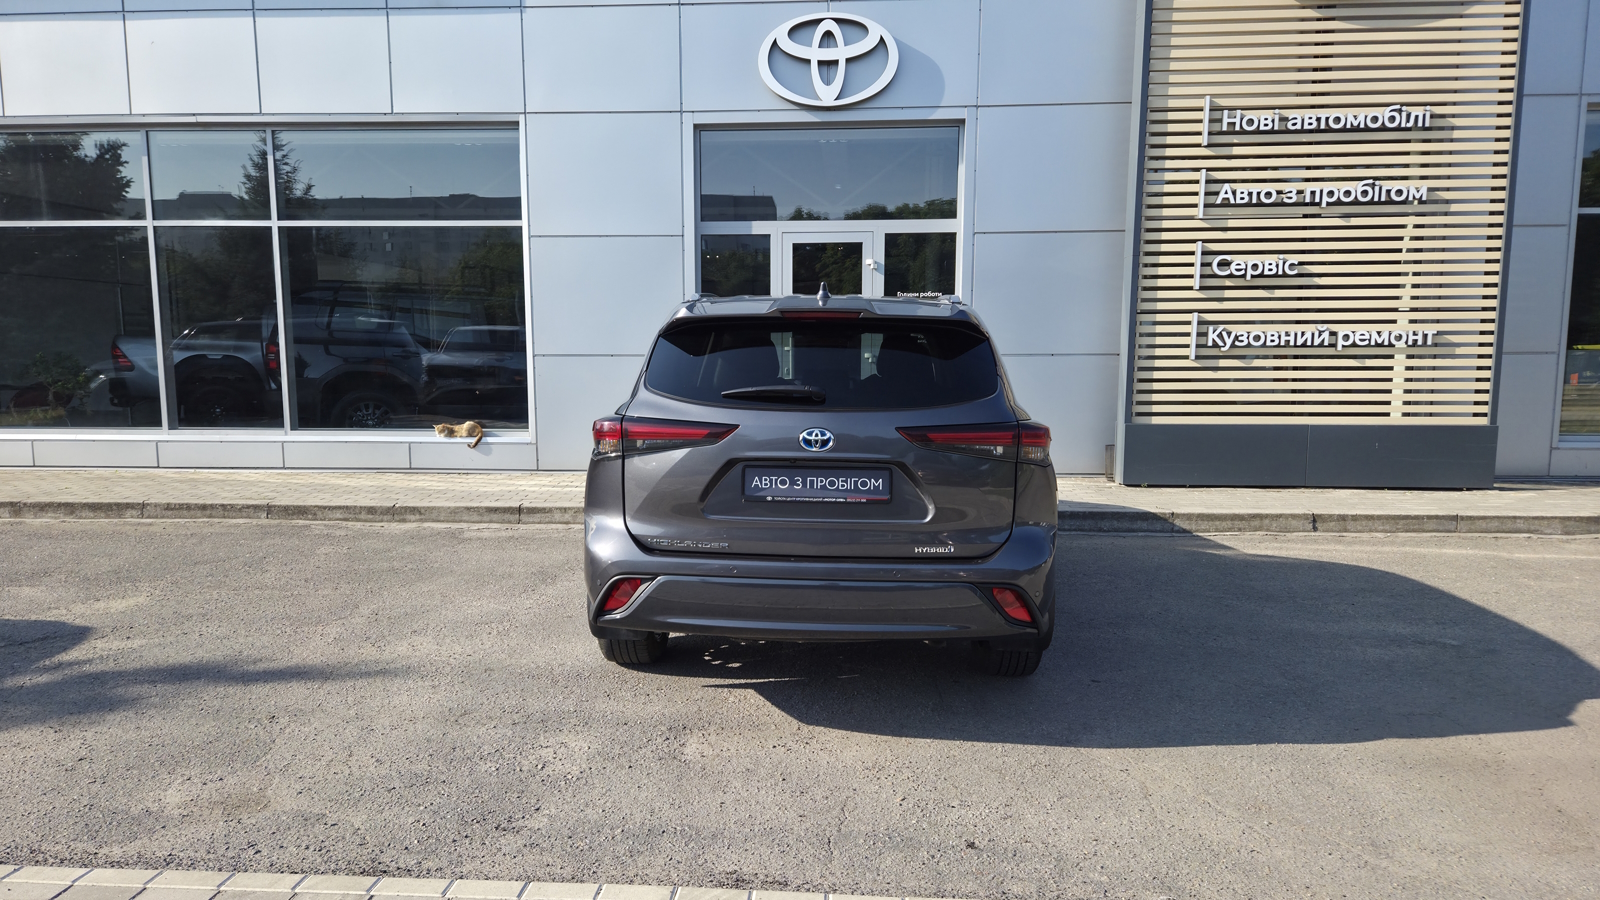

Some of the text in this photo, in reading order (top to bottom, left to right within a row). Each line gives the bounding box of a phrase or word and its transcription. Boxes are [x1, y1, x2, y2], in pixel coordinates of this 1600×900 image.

[1221, 104, 1431, 131] Нові автомобілі
[1215, 179, 1428, 208] Авто з пробігом
[1211, 254, 1299, 281] Сервіс
[919, 291, 942, 299] роботи
[1207, 325, 1438, 352] Кузовний ремонт
[751, 476, 883, 490] АВТО З ПРОБІГОМ
[647, 538, 729, 549] HIGHLANDER
